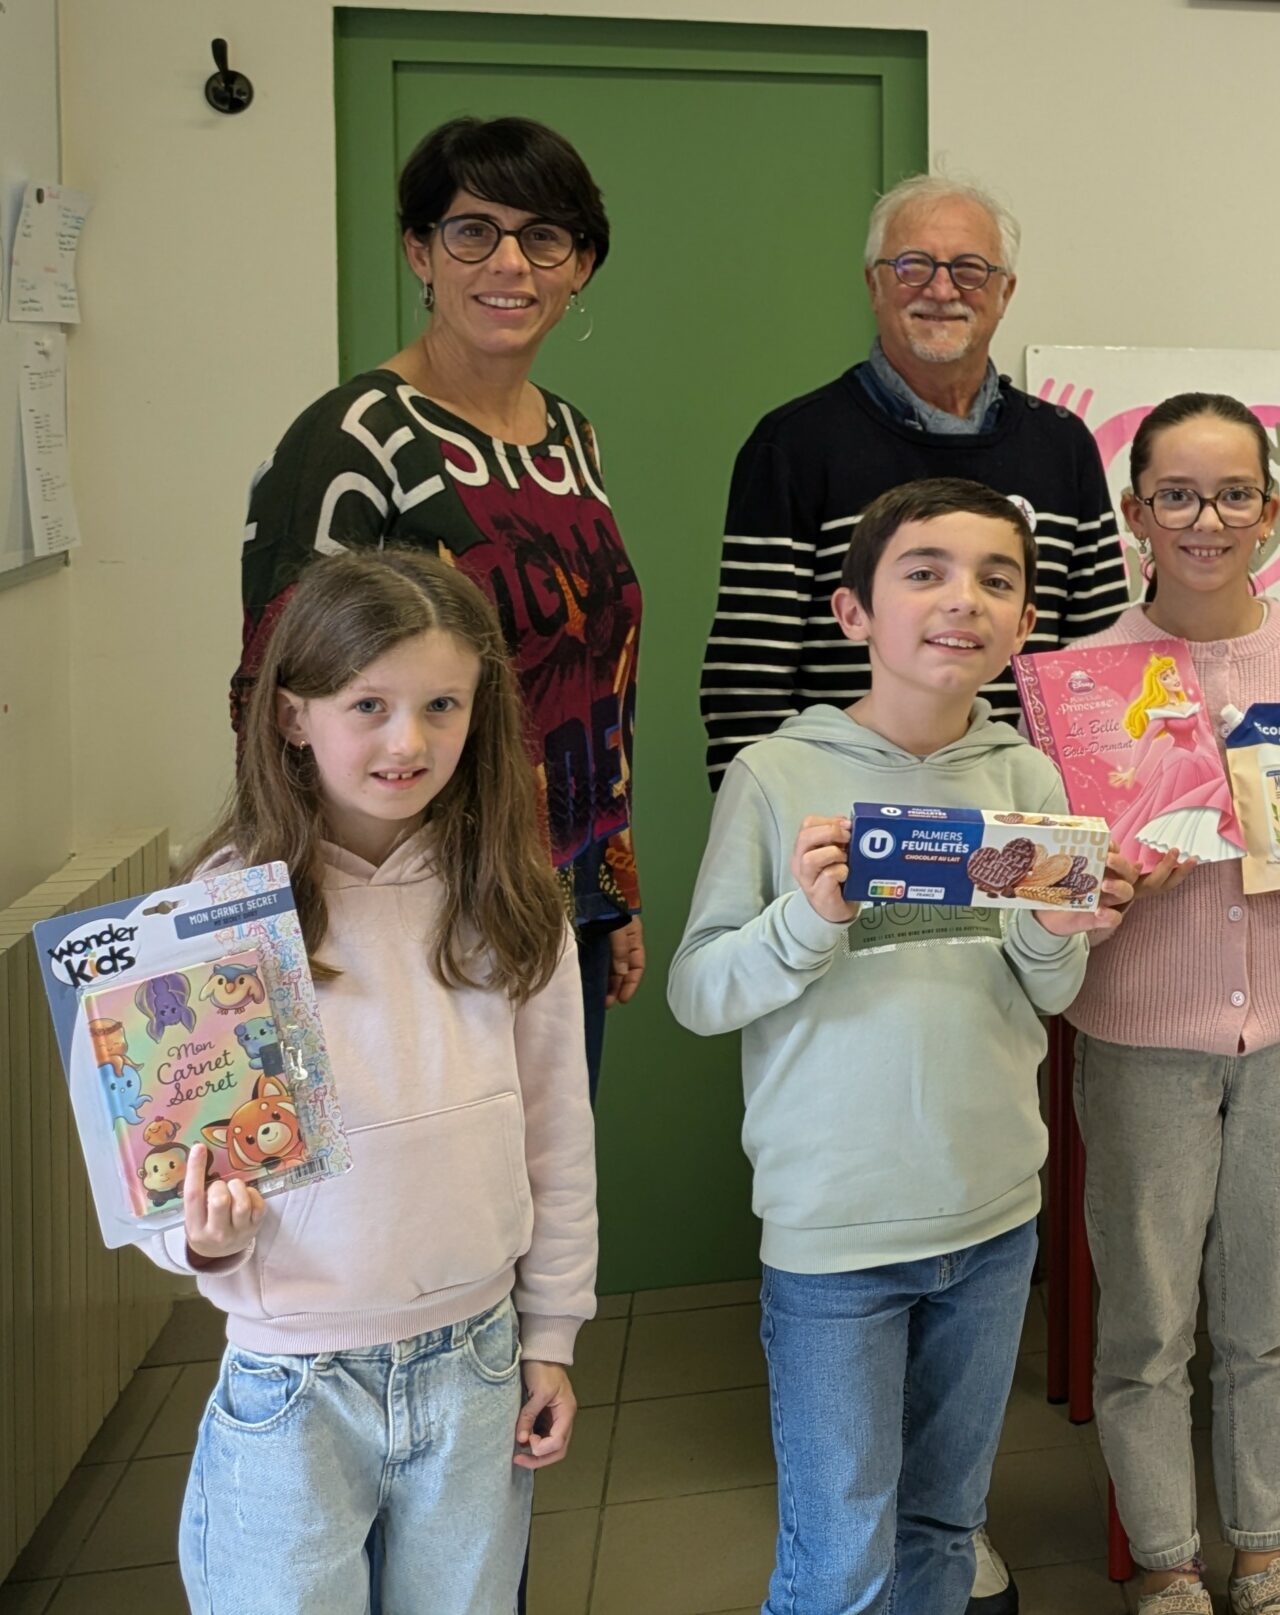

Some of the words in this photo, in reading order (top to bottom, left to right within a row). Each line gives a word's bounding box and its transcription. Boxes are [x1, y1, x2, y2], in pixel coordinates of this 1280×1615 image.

[1066, 722, 1085, 737] La
[1089, 719, 1119, 734] Belle
[869, 837, 887, 853] U
[912, 830, 963, 841] PALMIERS
[901, 841, 970, 854] FEUILLETÉS
[905, 854, 937, 862] CHOCOLAT
[189, 912, 209, 925] MON
[211, 903, 244, 919] CARNET
[246, 894, 278, 910] SECRET
[64, 946, 136, 989] kids
[167, 1040, 215, 1060] Mon
[157, 1050, 234, 1086] Carnet
[166, 1072, 237, 1107] Secret
